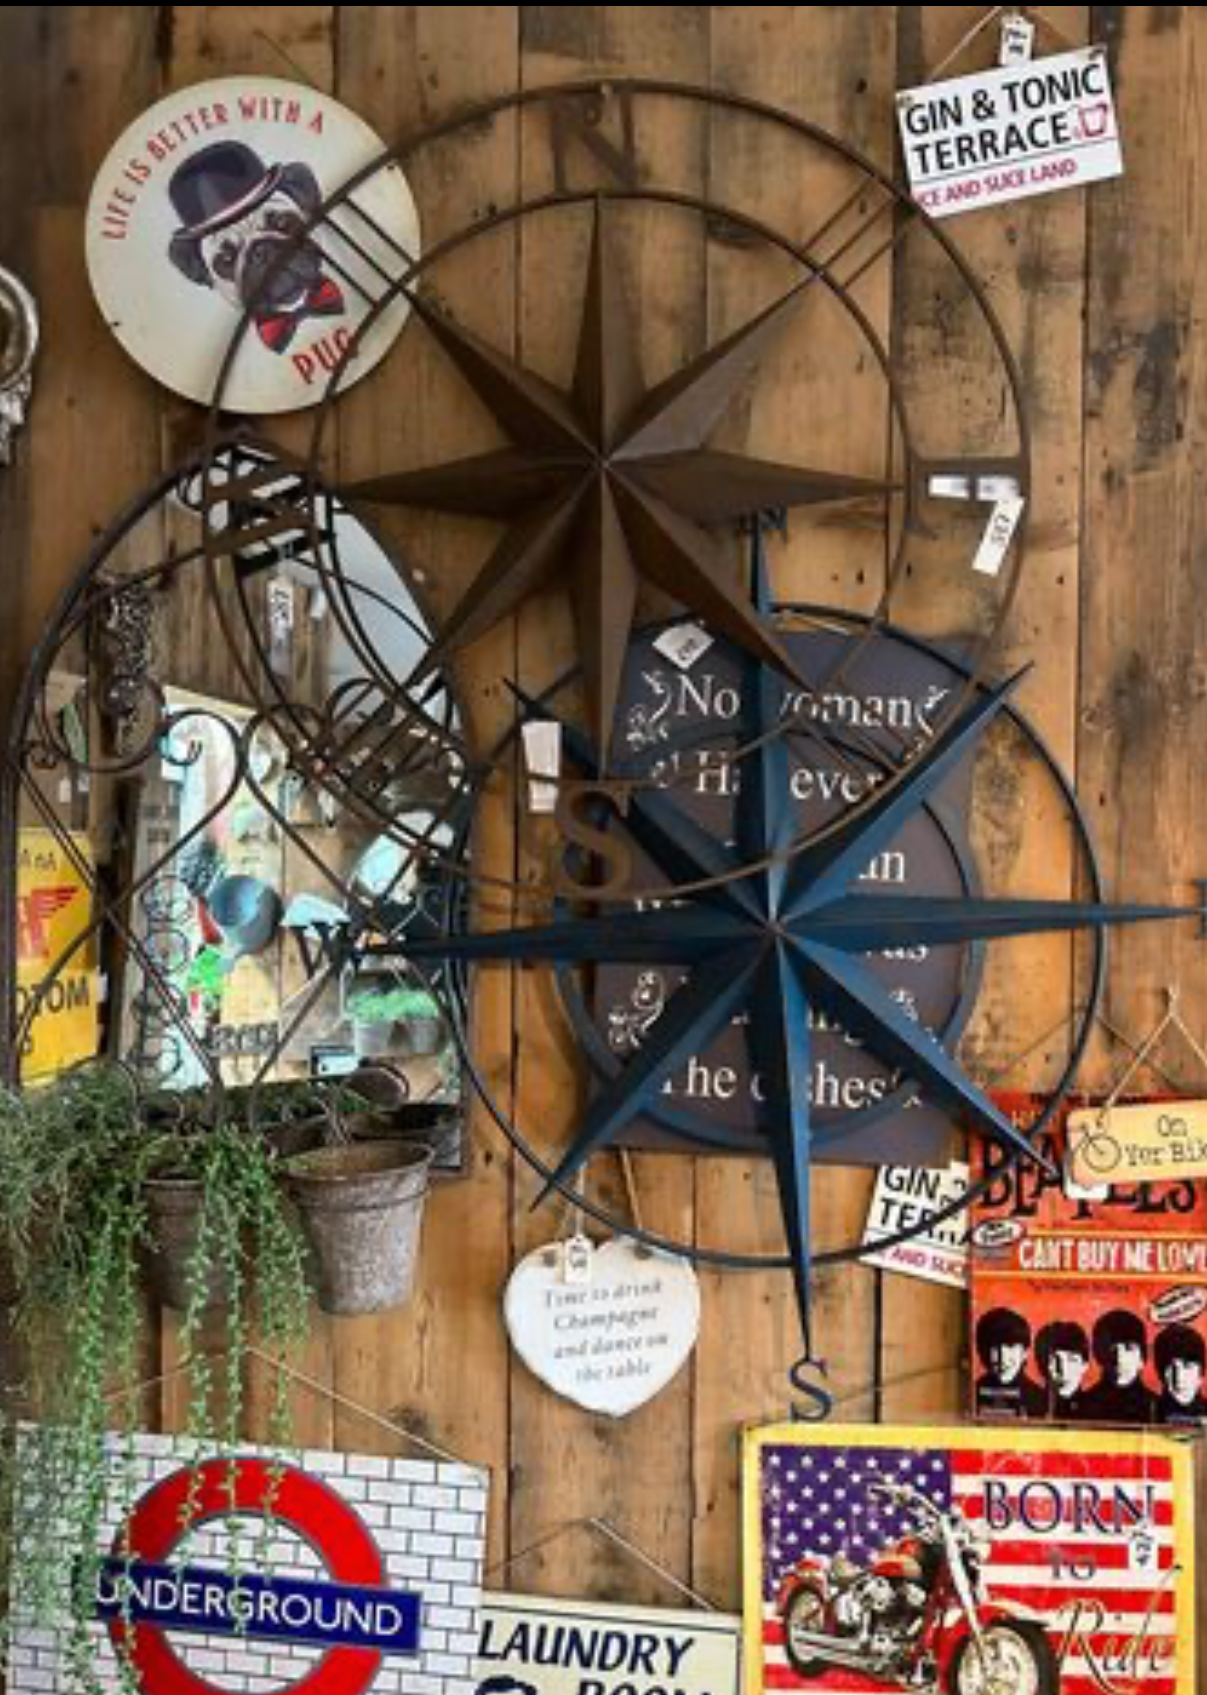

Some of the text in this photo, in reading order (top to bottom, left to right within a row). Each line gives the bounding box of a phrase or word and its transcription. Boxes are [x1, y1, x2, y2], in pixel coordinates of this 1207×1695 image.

[905, 63, 1104, 135] GIN & TONIC
[913, 111, 1071, 174] TERRACE
[101, 97, 323, 240] LIFE IS BETTER WITH A
[946, 179, 980, 200] AND
[1031, 158, 1078, 181] LAND
[676, 674, 740, 719] No
[884, 1167, 941, 1199] GIN
[1078, 1240, 1119, 1271] BUY
[1124, 1241, 1154, 1271] ME
[545, 1279, 663, 1308] Time is drink
[554, 1306, 660, 1333] Champagne
[554, 1333, 668, 1358] and dance on
[575, 1357, 651, 1382] the table
[788, 1356, 834, 1423] S
[983, 1480, 1156, 1535] BORN
[96, 1572, 403, 1636] UNDERGROUND
[477, 1619, 696, 1678] LAUNDRY
